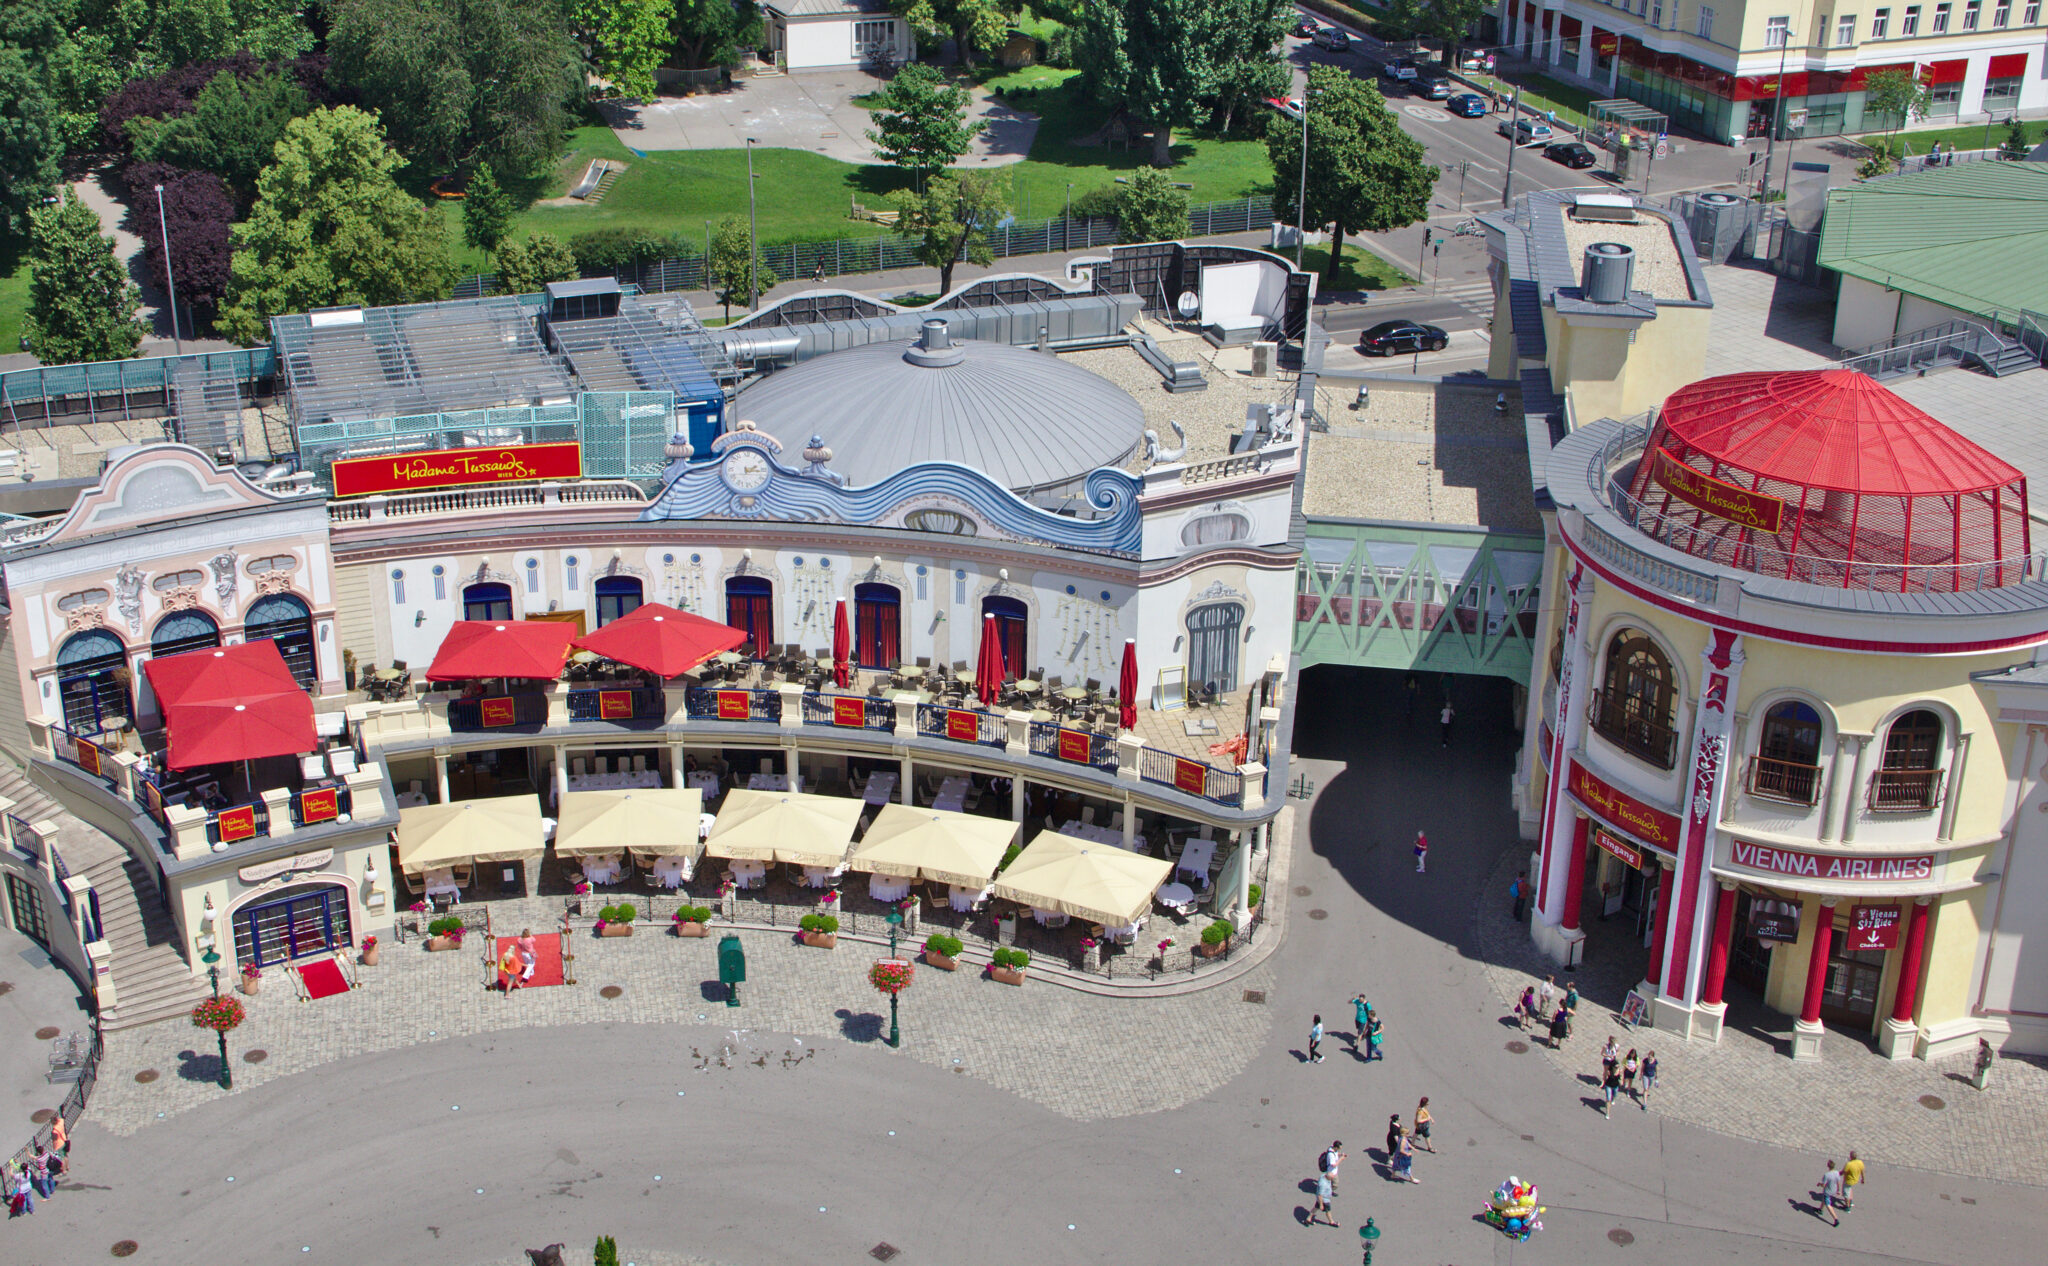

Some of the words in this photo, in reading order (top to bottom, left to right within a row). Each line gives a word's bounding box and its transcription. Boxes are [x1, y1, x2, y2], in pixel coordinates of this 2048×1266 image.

[393, 459, 459, 480] Madame
[454, 452, 527, 478] Tussauds
[1664, 463, 1702, 498] Madame
[1701, 484, 1759, 525] Tussauds
[1581, 776, 1616, 811] Madame
[1614, 799, 1661, 840] Tussauds
[1601, 836, 1635, 863] Eingang
[1735, 842, 1819, 876] VIENNA
[1826, 858, 1930, 880] AIRLINES
[1870, 909, 1898, 920] Vienna
[1874, 918, 1892, 928] Ride
